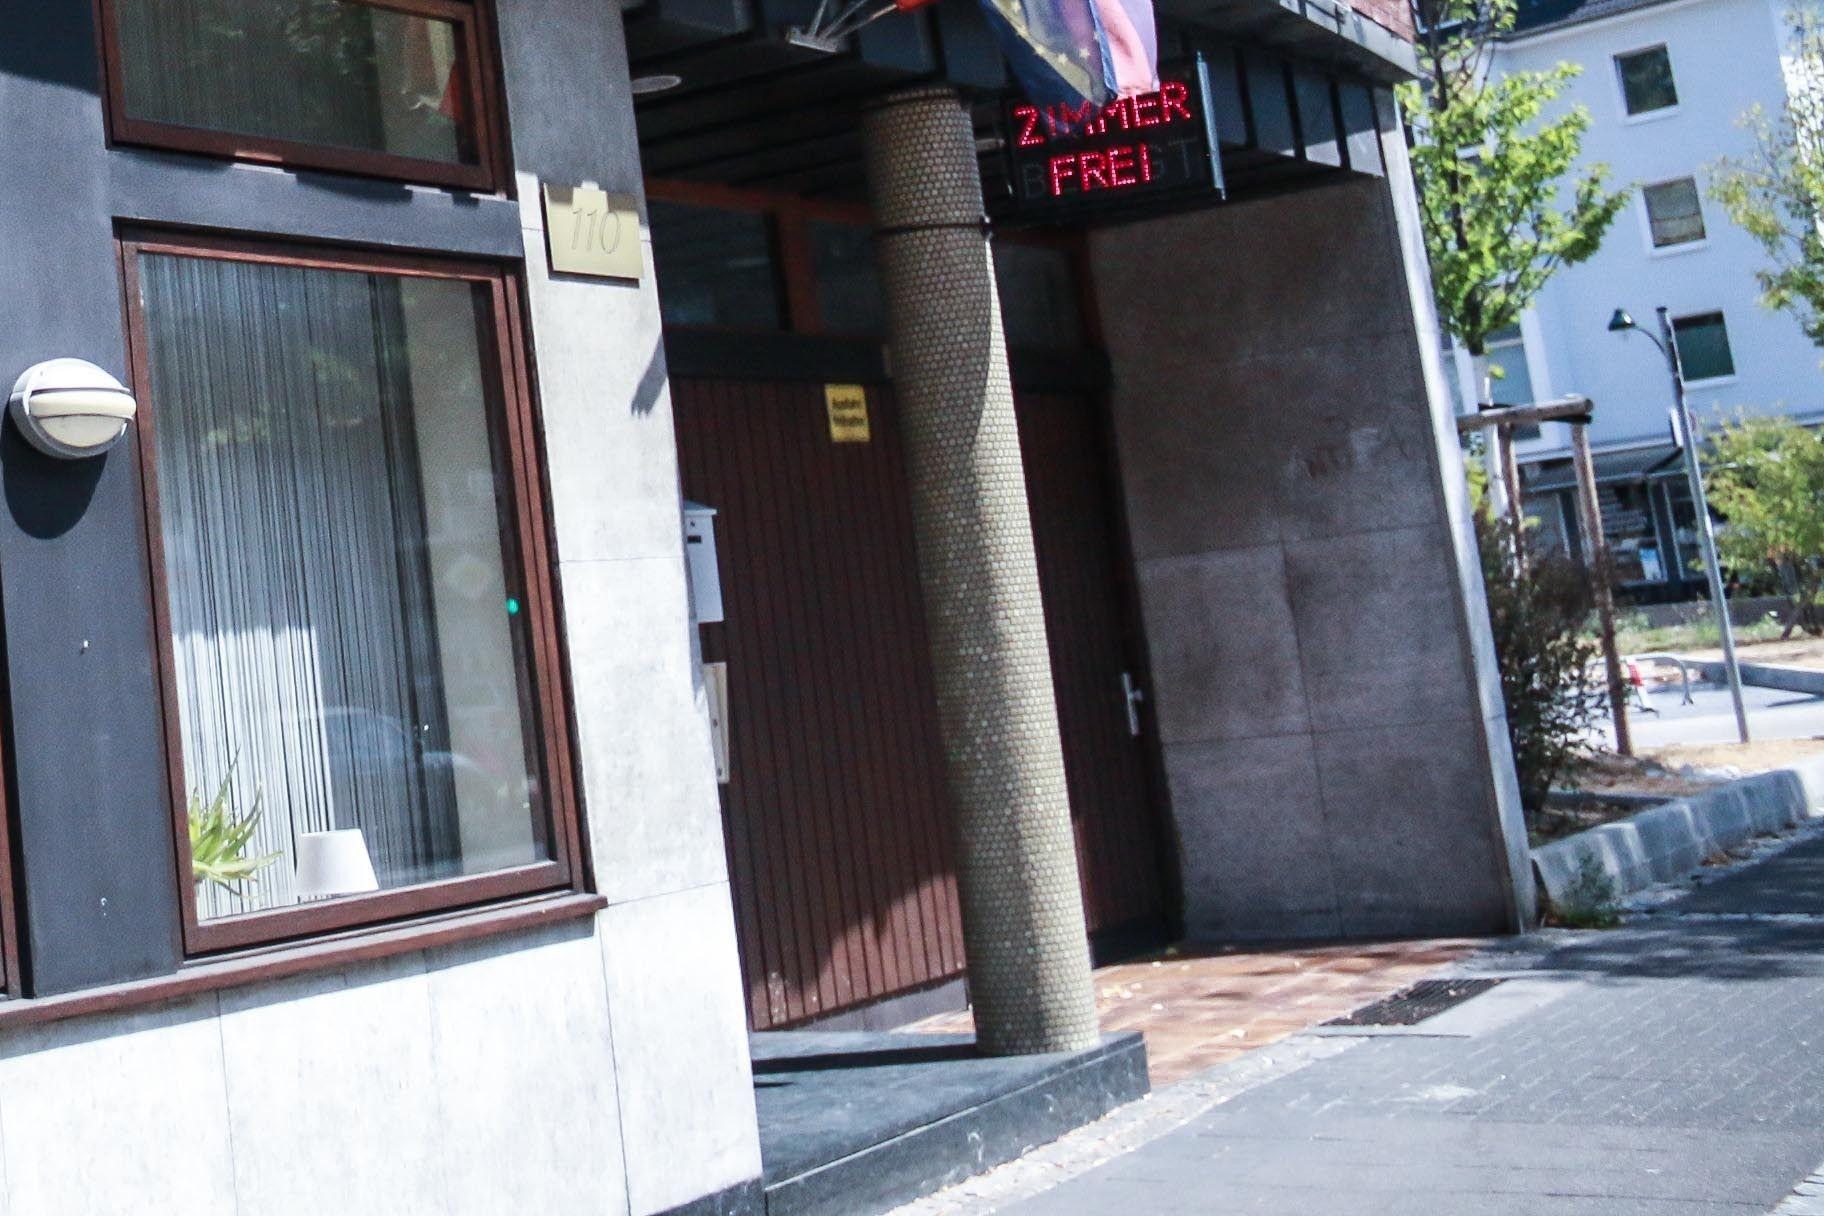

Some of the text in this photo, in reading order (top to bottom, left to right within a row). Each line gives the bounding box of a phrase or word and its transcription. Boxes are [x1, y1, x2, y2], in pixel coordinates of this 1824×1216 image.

[1013, 80, 1192, 147] ZIMMER
[1048, 143, 1153, 196] FREI
[570, 207, 622, 255] 110
